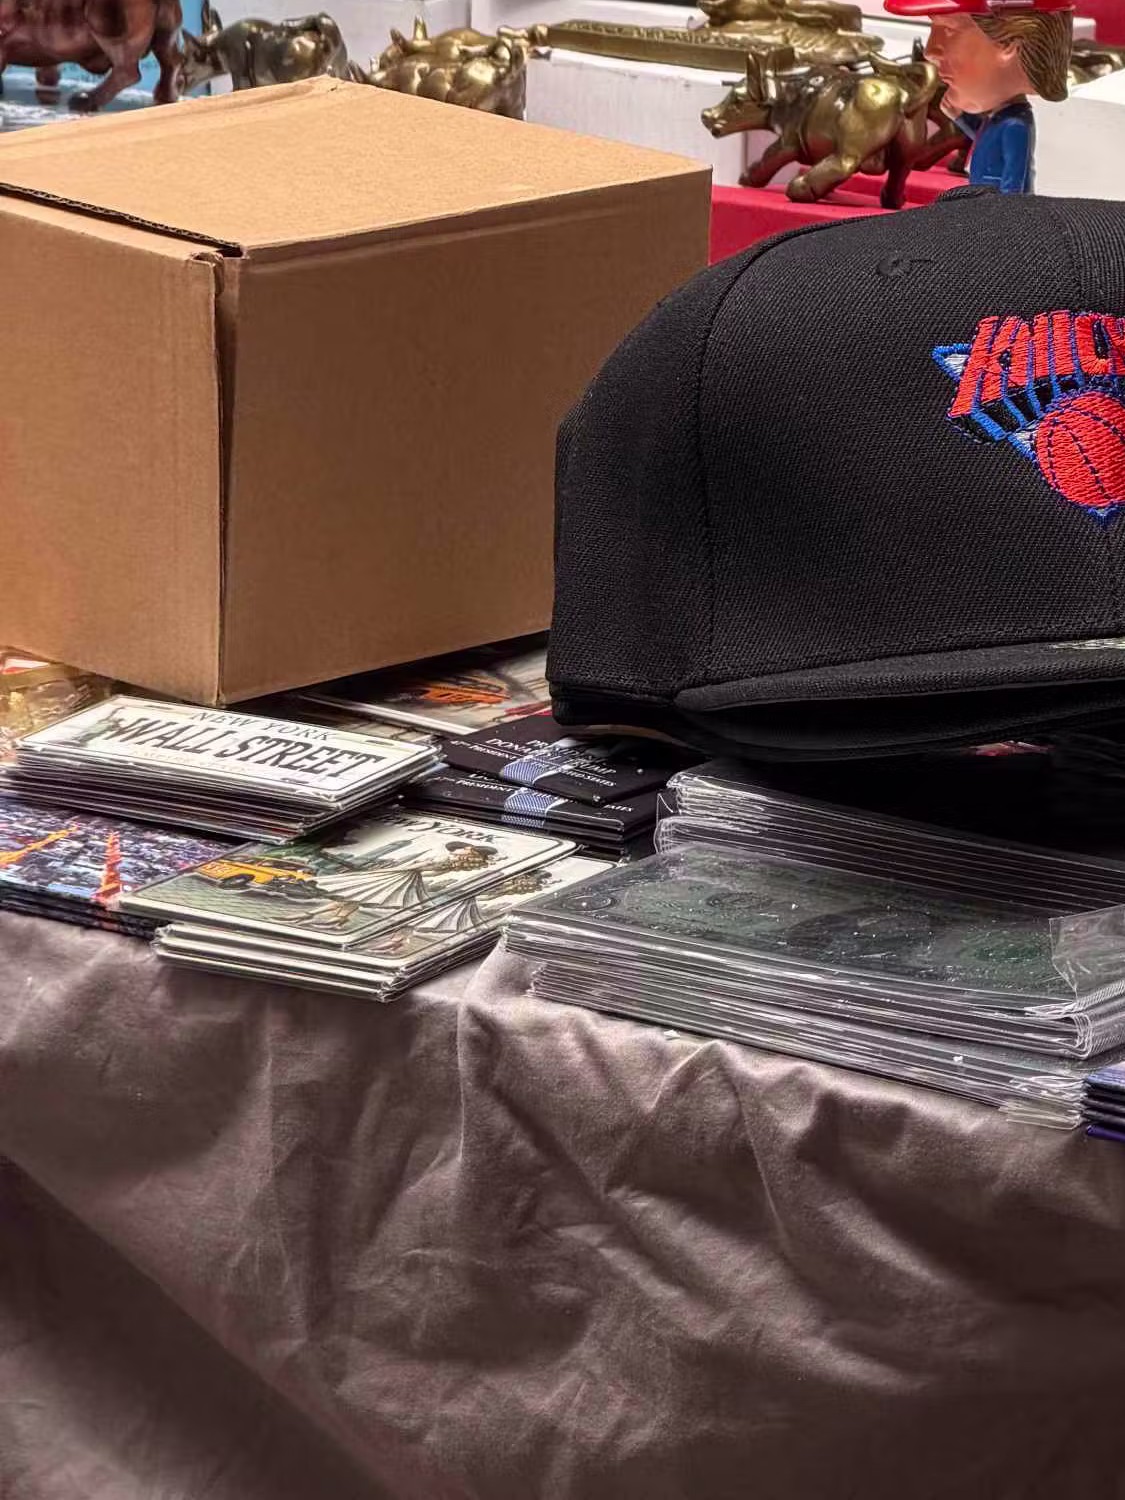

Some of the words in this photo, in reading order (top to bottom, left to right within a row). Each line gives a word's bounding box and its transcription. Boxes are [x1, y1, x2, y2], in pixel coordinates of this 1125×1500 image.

[113, 717, 235, 754] WALL
[213, 734, 386, 777] STREET
[188, 711, 257, 728] NEW
[264, 719, 338, 741] YORK
